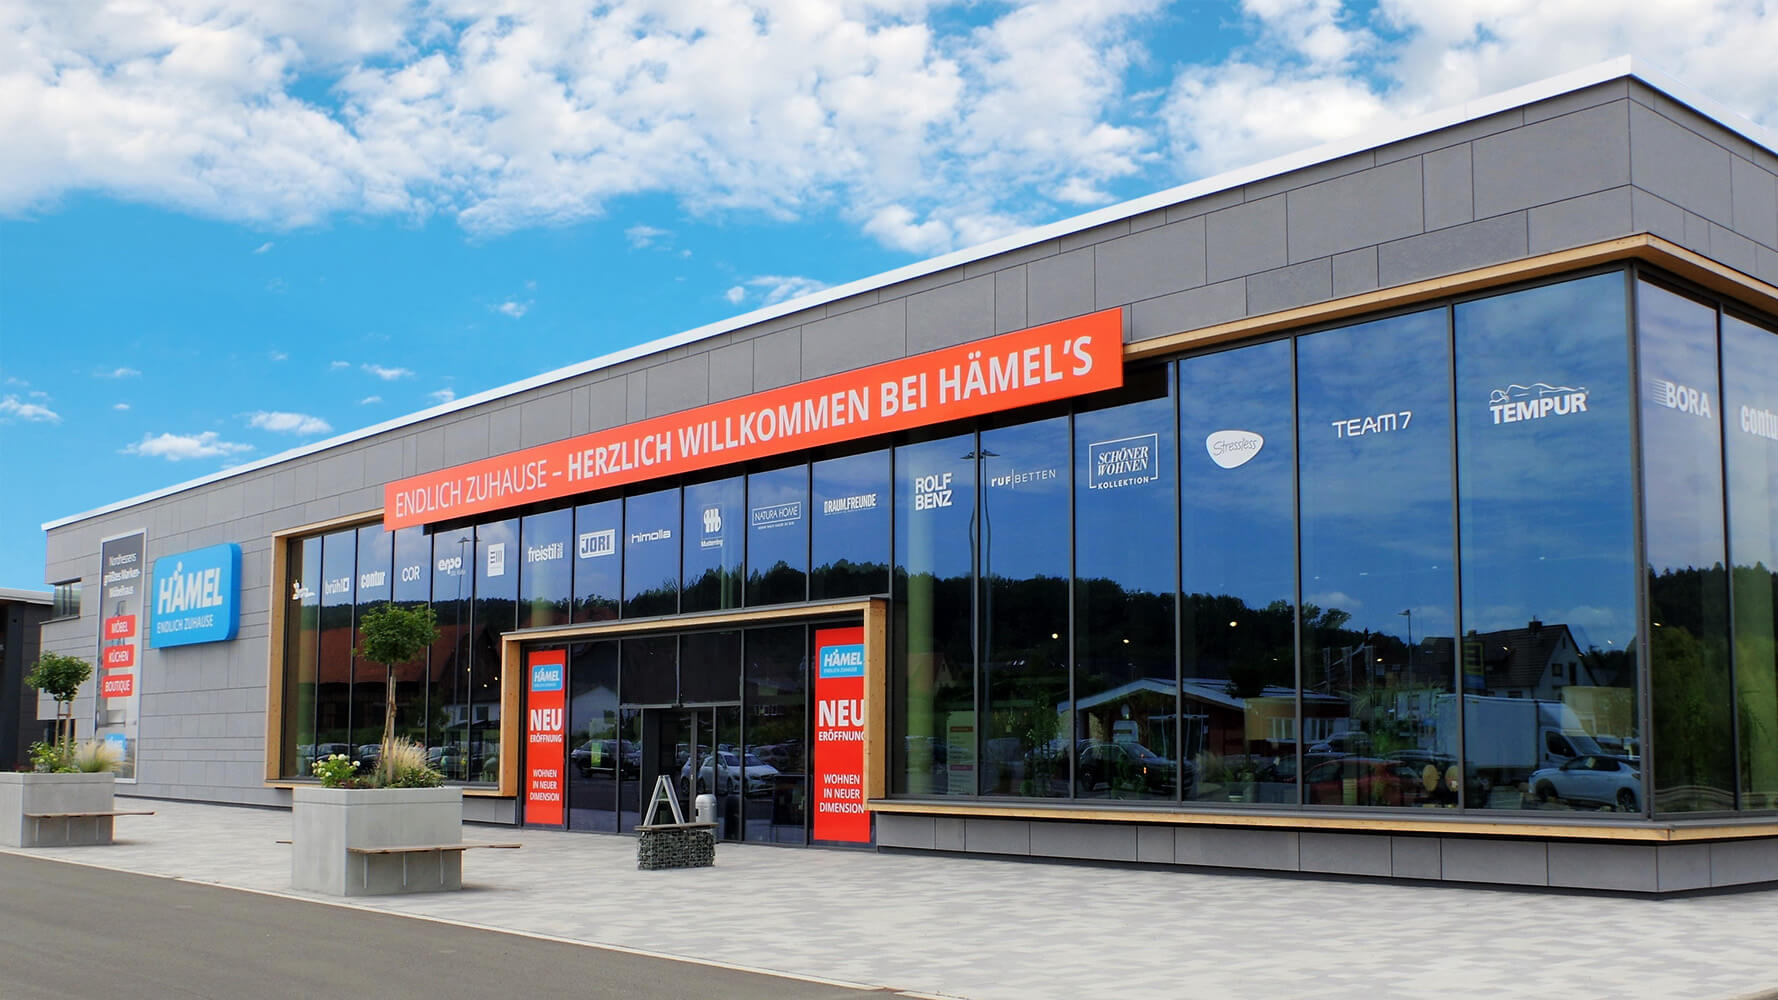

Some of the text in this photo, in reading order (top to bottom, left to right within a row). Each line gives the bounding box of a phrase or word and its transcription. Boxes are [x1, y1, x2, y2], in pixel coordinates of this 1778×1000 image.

[1490, 392, 1588, 424] TEMPUR
[1664, 382, 1712, 419] BORA
[1332, 410, 1413, 438] TEAM 7
[1740, 405, 1778, 441] contu
[395, 484, 462, 518] ENDLICH
[465, 460, 547, 504] ZUHAUSE
[567, 431, 672, 482] HERZLICH
[678, 386, 869, 458] WILLKOMMEN
[880, 372, 927, 418] BEI
[1212, 437, 1258, 456] Stressless
[1097, 445, 1149, 466] SCHÖNER
[1014, 469, 1057, 483] BETTEN
[1097, 457, 1149, 477] WOHNEN
[915, 472, 952, 494] ROLF
[1097, 476, 1150, 490] KOLLEKTION
[915, 490, 952, 511] BENZ
[754, 505, 799, 521] NATURA HOME
[582, 533, 611, 554] JORI
[631, 529, 671, 544] himolla
[528, 543, 556, 562] freistil
[361, 571, 386, 589] contur
[402, 565, 420, 582] COR
[157, 615, 213, 634] ENDLICH ZUHAUSE
[108, 649, 130, 663] KÜCHEN
[104, 680, 131, 693] BOUTIQUE
[530, 708, 563, 732] NEU
[819, 699, 864, 727] NEU
[530, 733, 562, 743] ERÖFFNUNG
[533, 769, 557, 778] WOHNEN
[824, 774, 860, 784] WOHNEN
[533, 781, 557, 790] IN NEUER
[824, 788, 860, 799] IN NEUER
[530, 792, 560, 801] DIMENSION
[820, 802, 864, 813] DIMENSION
